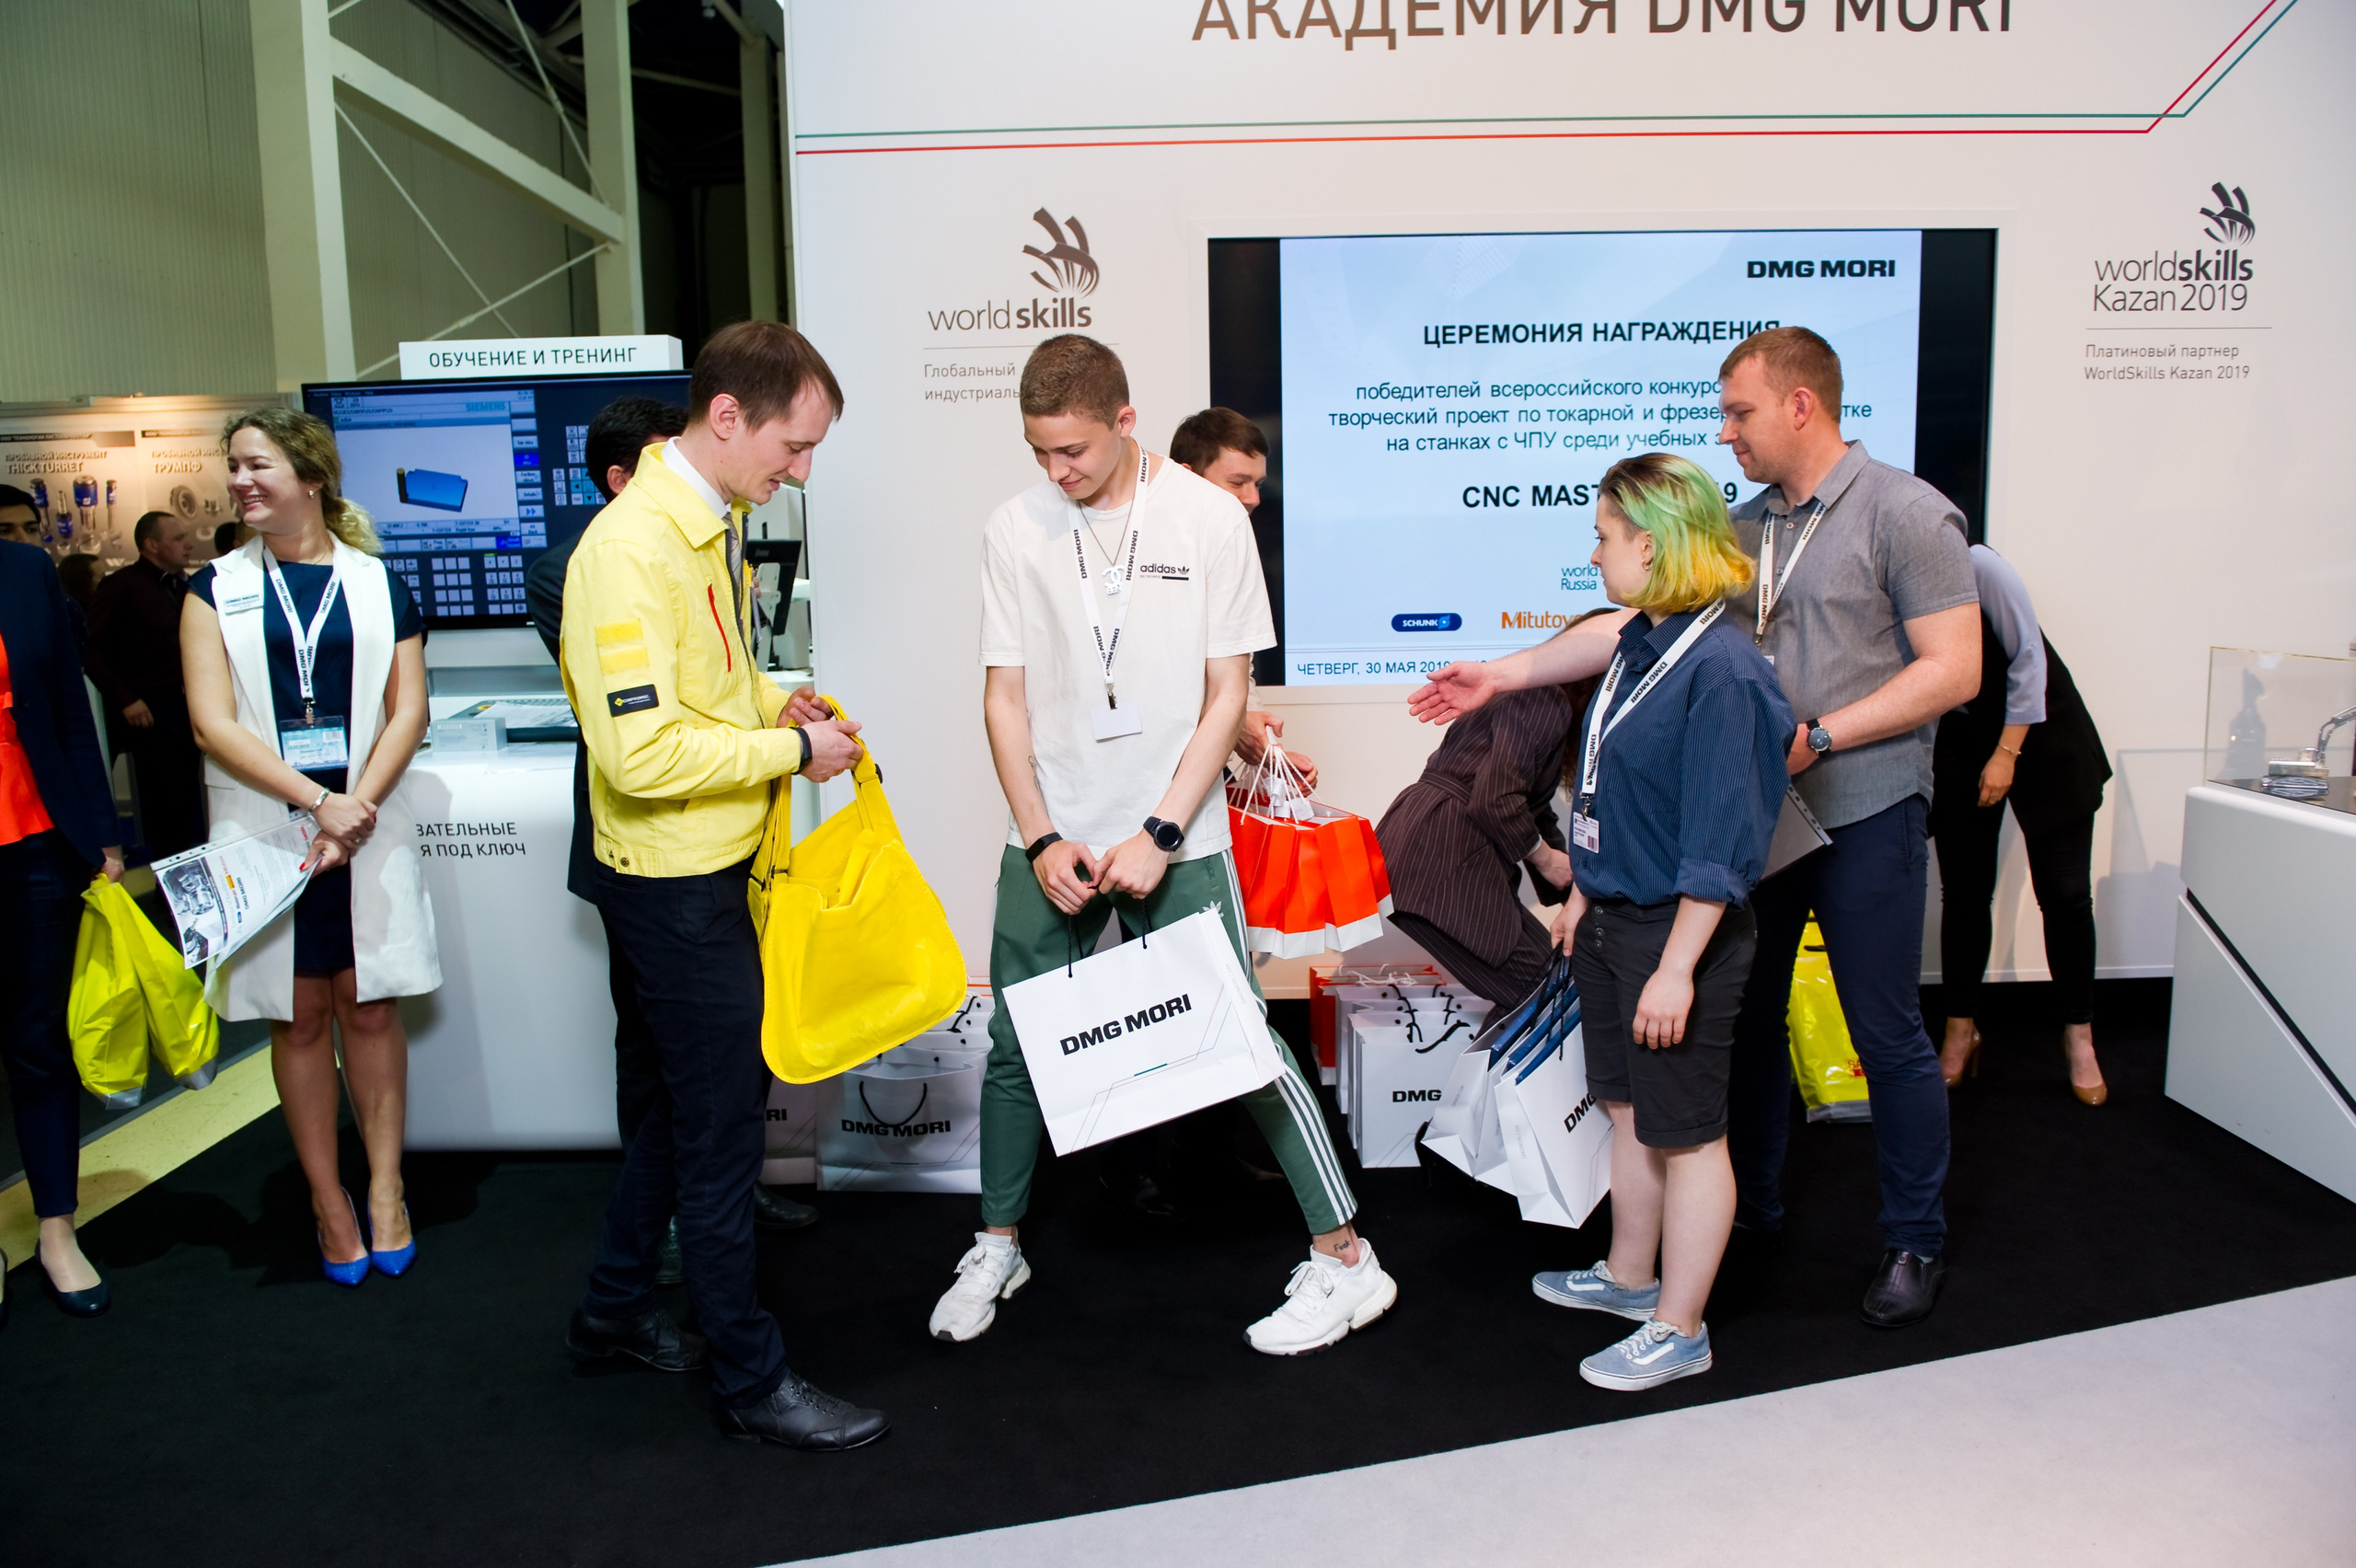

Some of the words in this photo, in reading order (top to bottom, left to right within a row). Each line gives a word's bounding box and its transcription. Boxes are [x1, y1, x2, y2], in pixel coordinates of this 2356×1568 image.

[1192, 0, 1617, 51] АКАДЕМИЯ
[1747, 260, 1815, 278] DMG
[1820, 259, 1896, 277] MORI
[2095, 249, 2254, 282] worldskills
[2094, 284, 2176, 311] Kazan
[2180, 283, 2248, 311] 2019
[928, 297, 1092, 330] worldskills
[1424, 323, 1583, 348] ЦЕРЕМОНИЯ
[429, 350, 527, 367] ОБУЧЕНИЕ
[534, 350, 545, 364] И
[551, 348, 637, 364] ТРЕНИНГ
[2085, 344, 2177, 358] Платиновый
[2181, 347, 2239, 360] партнер
[924, 363, 1016, 378] Глобальный
[2085, 366, 2165, 380] WorldSkills
[2170, 366, 2212, 379] Kazan
[2217, 365, 2250, 379] 2019
[925, 388, 1021, 403] индустриаль
[1357, 381, 1481, 402] победителей
[1491, 378, 1643, 401] всероссийского
[1329, 408, 1438, 430] творческий
[1446, 409, 1509, 428] проект
[1519, 409, 1541, 422] по
[1547, 405, 1634, 425] токарной
[1643, 406, 1654, 420] и
[1387, 437, 1409, 451] на
[1416, 435, 1490, 450] станках
[1497, 435, 1507, 449] с
[1514, 432, 1556, 449] ЧПУ
[1564, 432, 1620, 452] среди
[1626, 429, 1707, 451] учебных
[6, 463, 38, 475] THICK
[40, 461, 84, 474] TURRET
[155, 461, 202, 474] ТРУМПФ
[1463, 485, 1519, 508] CNC
[1073, 529, 1082, 555] MORI
[1130, 530, 1138, 554] DMG
[1079, 556, 1088, 579] DMG
[1126, 555, 1135, 581] MORI
[1140, 563, 1177, 574] adidas
[326, 582, 336, 599] MORI
[1561, 578, 1597, 590] Russia
[276, 579, 286, 594] DMG
[283, 595, 294, 613] MORI
[1403, 619, 1438, 628] SCHUNK
[1699, 605, 1720, 625] MORI
[1093, 626, 1104, 651] MORI
[1110, 628, 1120, 651] DMG
[298, 649, 307, 669] DMG
[1297, 662, 1360, 675] ЧЕТВЕРГ,
[1366, 663, 1381, 674] 30
[1386, 662, 1415, 674] МАЯ
[1605, 668, 1620, 692] MORI
[1648, 661, 1669, 683] DMG
[1630, 680, 1650, 703] MORI
[1588, 733, 1597, 757] DMG
[415, 822, 517, 837] ЗАТЕЛЬНЫЕ
[436, 843, 473, 859] ПОД
[477, 843, 526, 856] КЛЮЧ
[1060, 1020, 1123, 1056] DMG
[1124, 993, 1193, 1033] MORI
[1392, 1090, 1442, 1102] DMG
[841, 1119, 889, 1136] DMG
[892, 1120, 951, 1137] MORI
